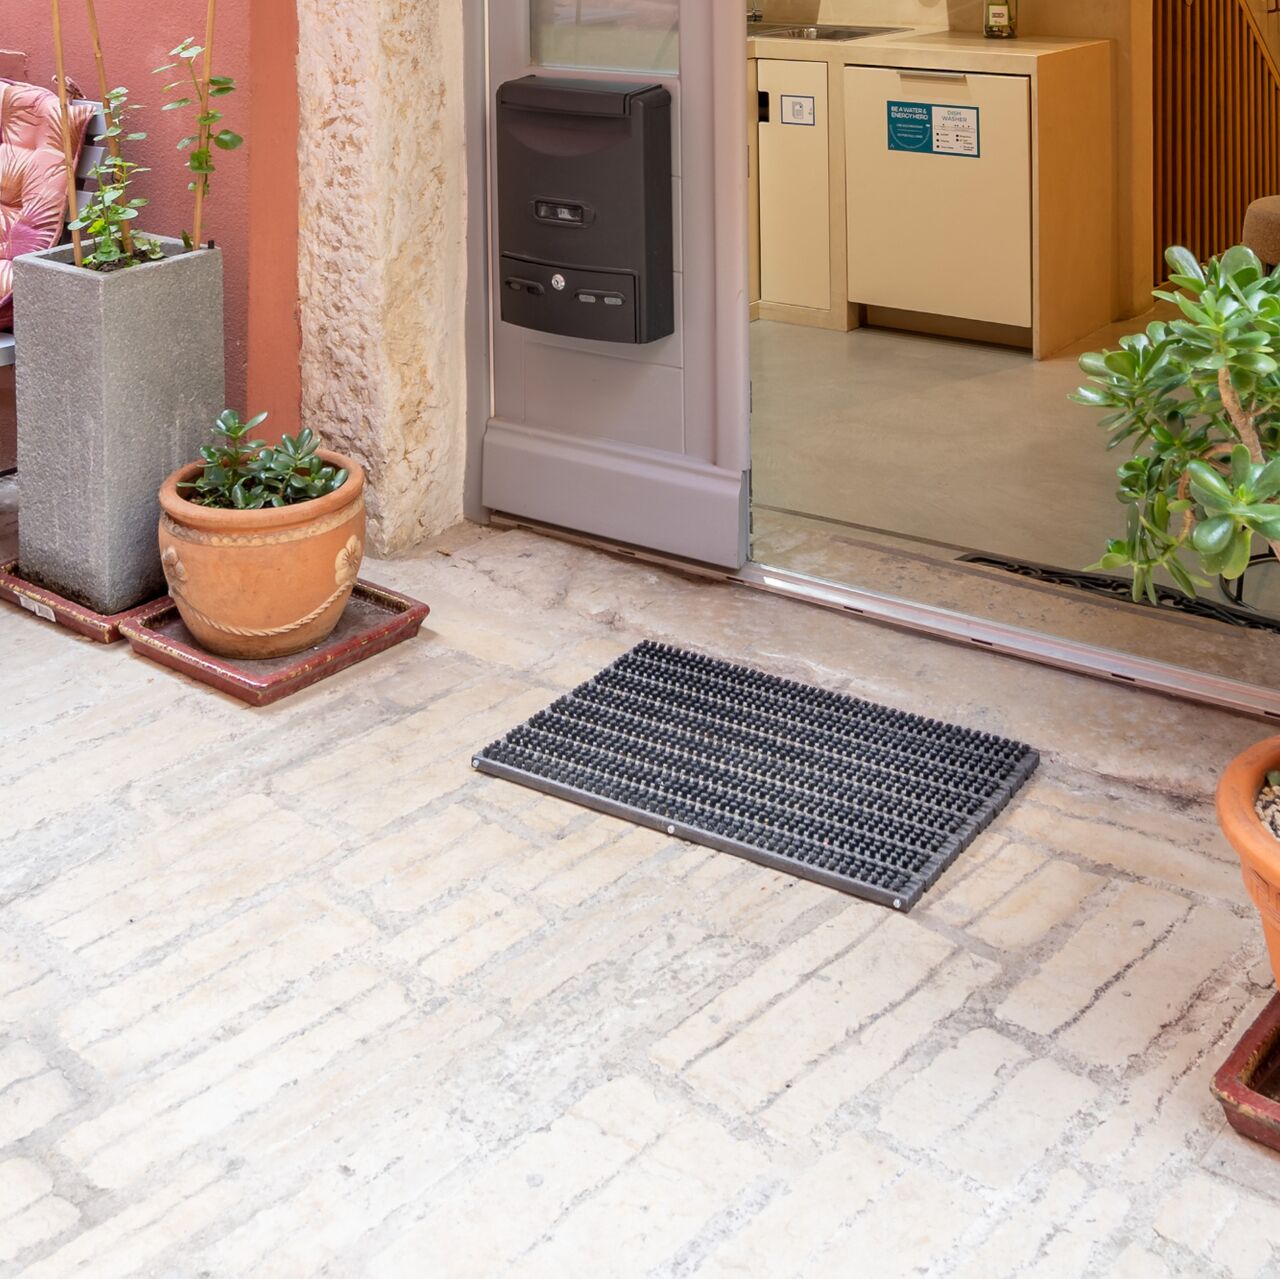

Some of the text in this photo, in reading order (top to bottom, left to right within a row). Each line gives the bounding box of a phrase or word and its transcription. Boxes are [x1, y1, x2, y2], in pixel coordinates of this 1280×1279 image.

[903, 106, 923, 114] WATER
[891, 112, 929, 121] ENERGY HERO
[942, 115, 967, 123] WASHER
